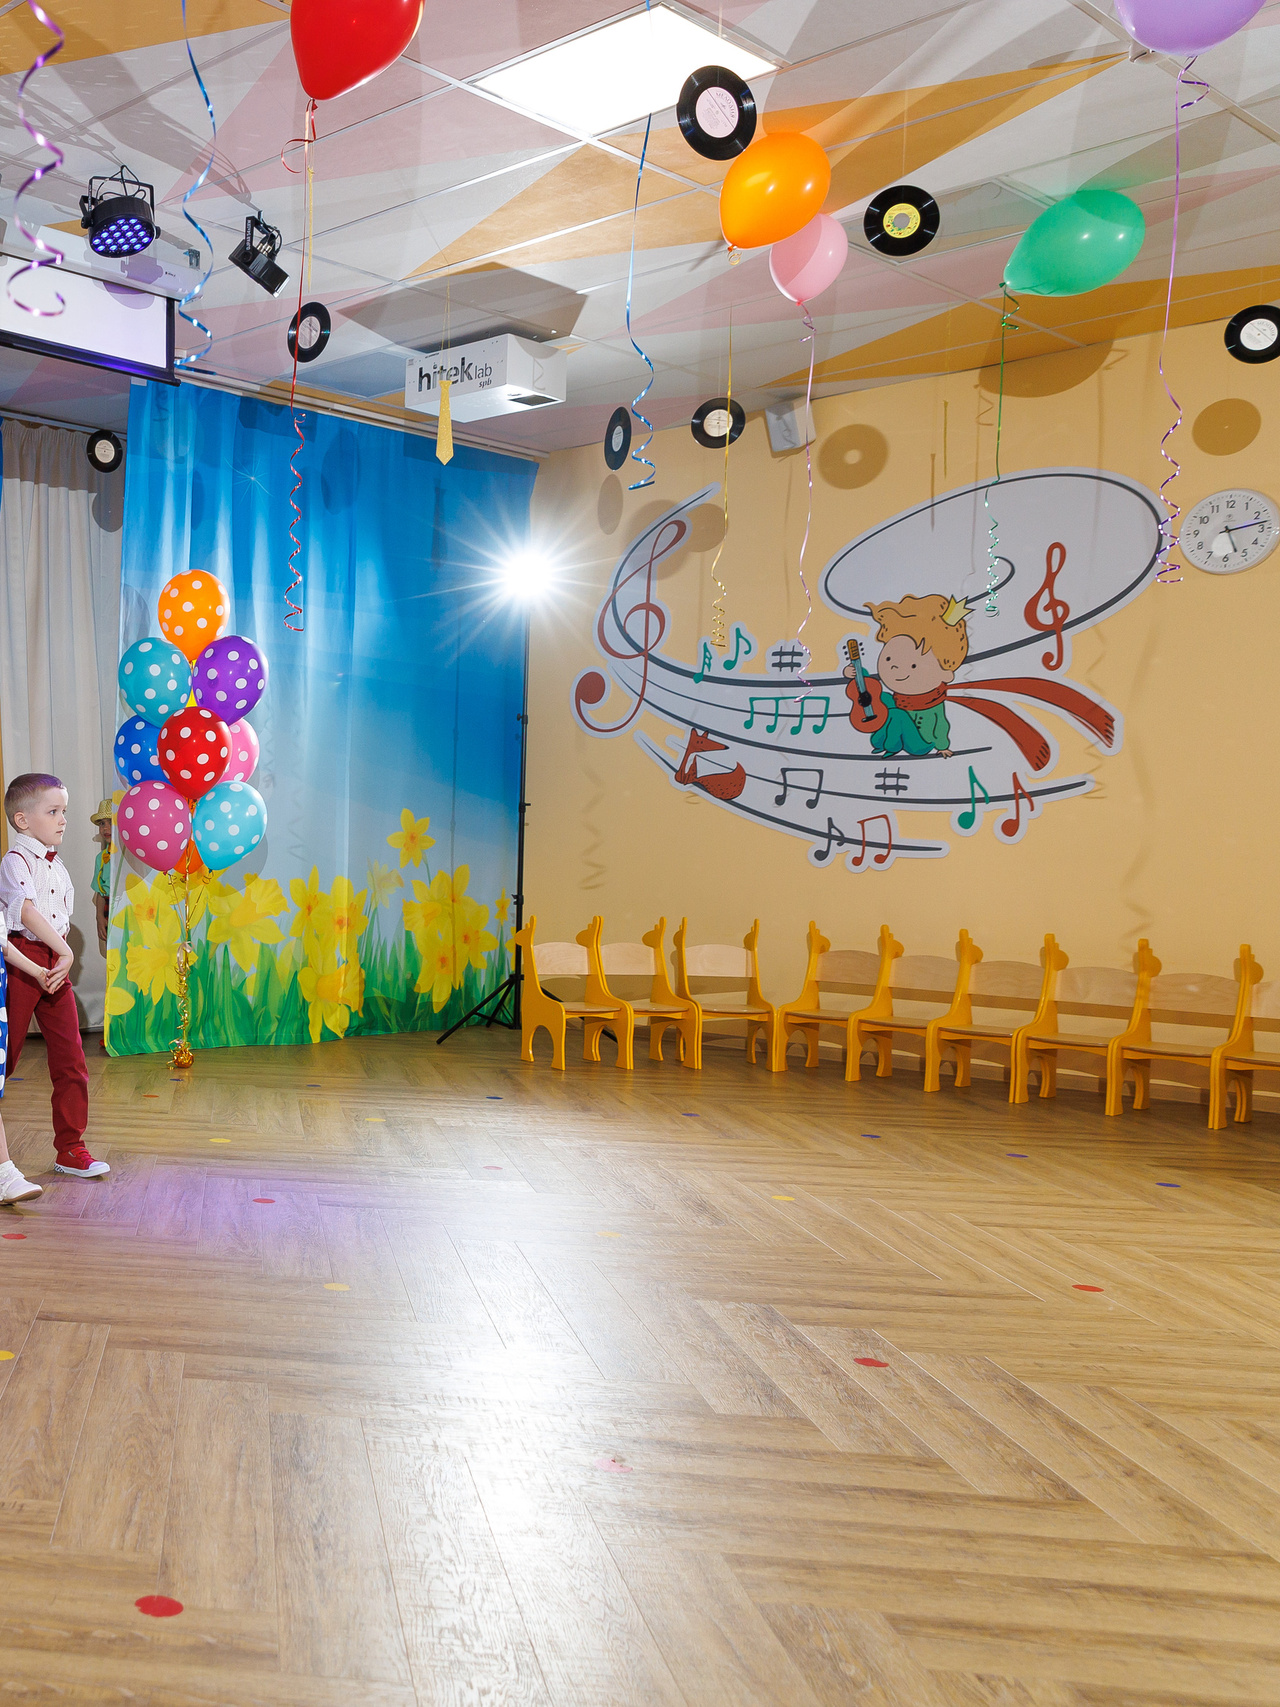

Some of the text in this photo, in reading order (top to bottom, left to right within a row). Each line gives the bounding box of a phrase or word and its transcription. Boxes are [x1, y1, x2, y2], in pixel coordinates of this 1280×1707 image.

[474, 363, 492, 379] lab
[1226, 500, 1236, 508] 12
[1245, 502, 1249, 510] 1
[1211, 505, 1220, 513] 11
[1254, 511, 1261, 520] 2
[1199, 516, 1209, 524] 10
[1258, 524, 1265, 533] 3
[1193, 529, 1200, 538] 9
[1251, 537, 1258, 545] 4
[1197, 542, 1204, 550] 8
[1207, 551, 1213, 560] 7
[1241, 549, 1248, 557] 5
[1222, 554, 1229, 562] 6
